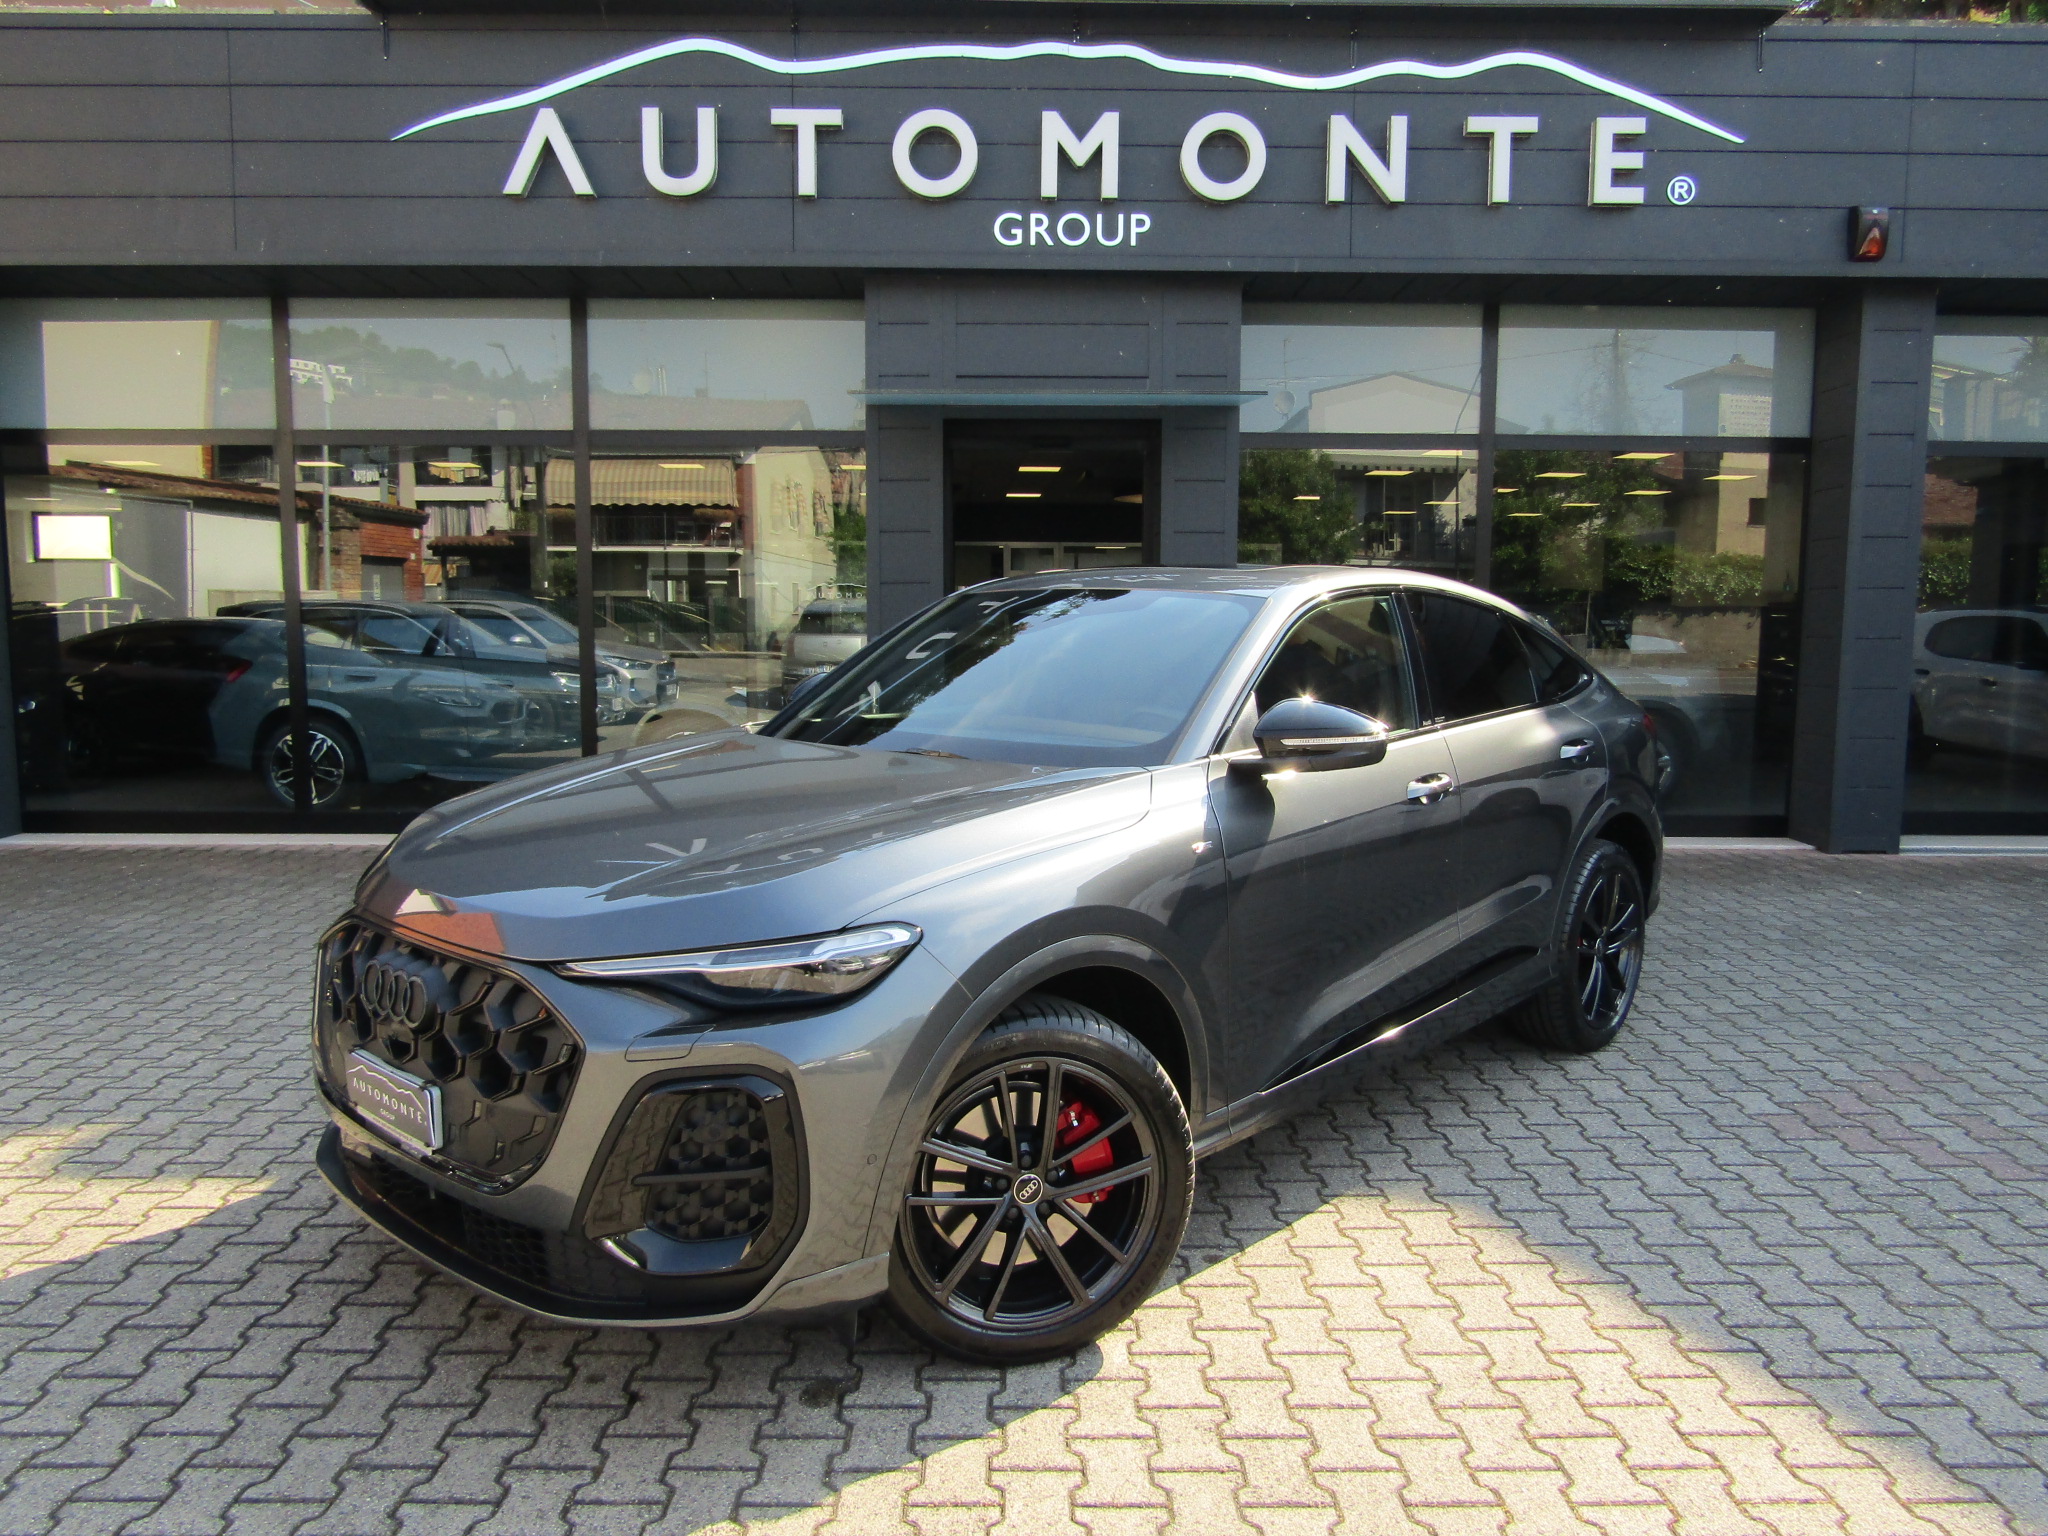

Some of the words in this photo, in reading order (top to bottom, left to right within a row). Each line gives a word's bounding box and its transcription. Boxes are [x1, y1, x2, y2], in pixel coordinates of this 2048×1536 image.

[502, 106, 1648, 206] AUTOMONTE
[993, 212, 1152, 247] GROUP
[353, 1077, 423, 1124] AUTOMONTE
